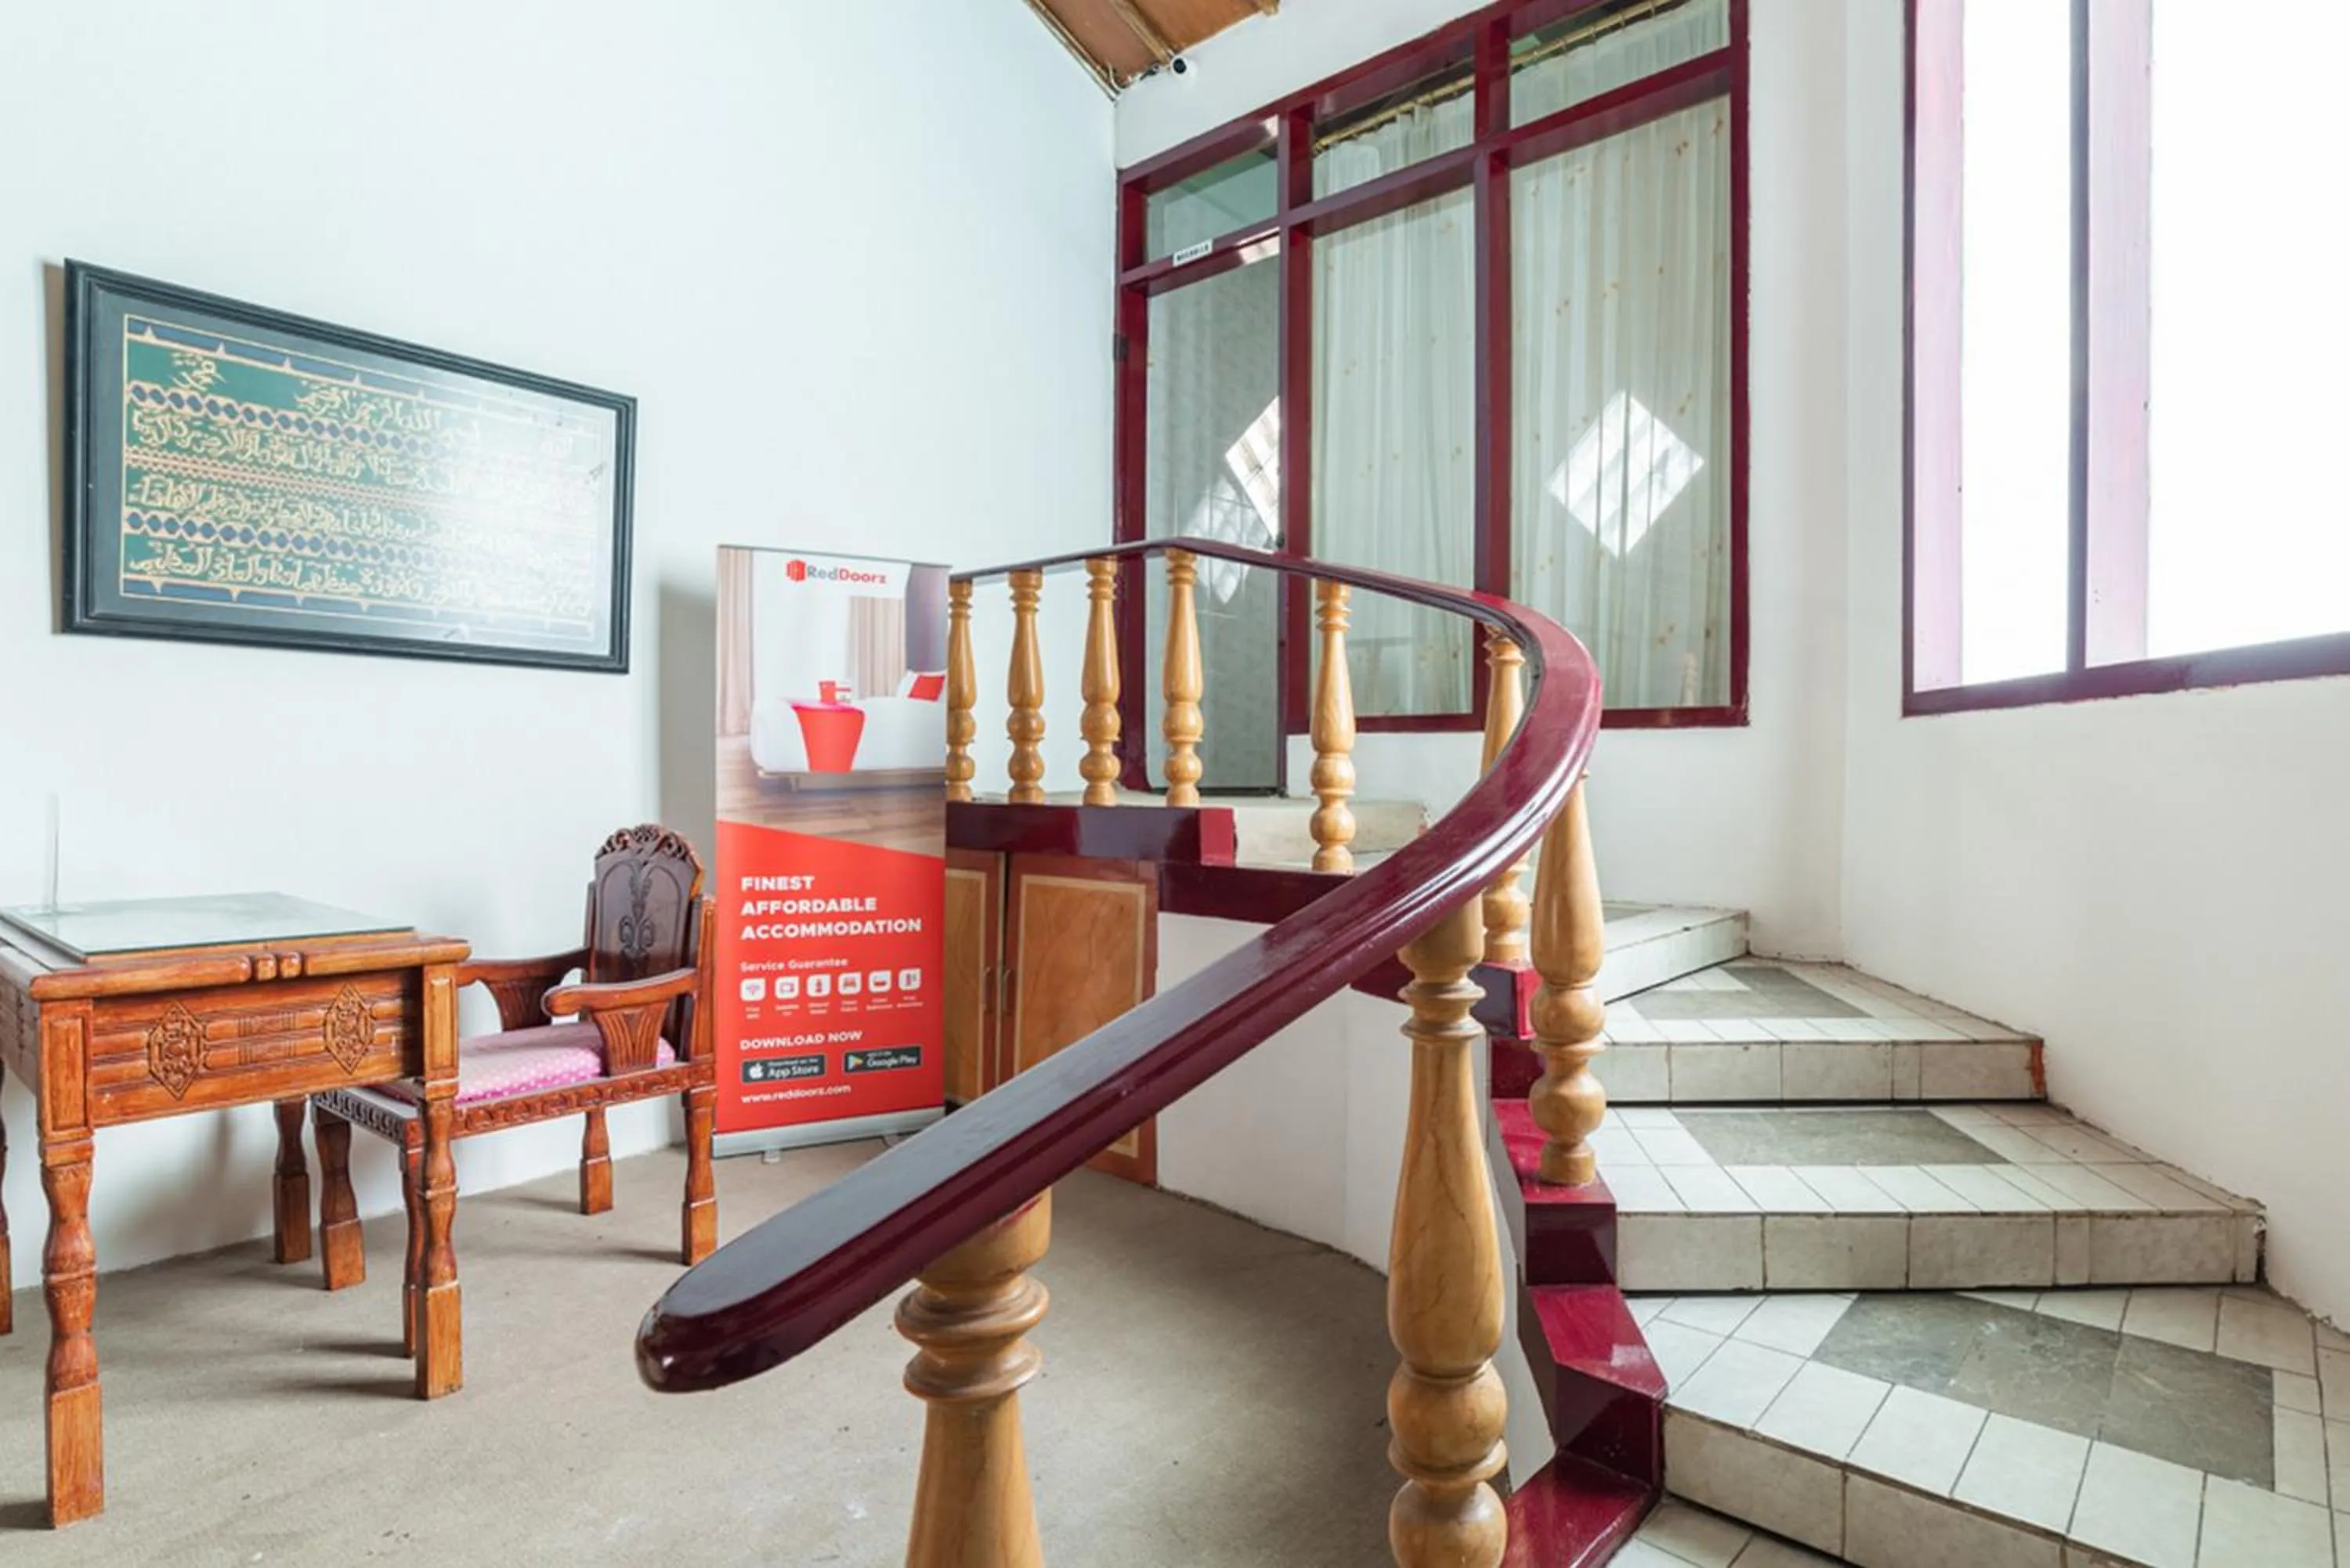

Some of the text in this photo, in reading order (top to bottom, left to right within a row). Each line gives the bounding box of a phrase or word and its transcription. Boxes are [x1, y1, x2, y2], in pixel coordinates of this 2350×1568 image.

[807, 565, 887, 583] RedDoorz
[740, 875, 815, 891] FINEST
[740, 897, 877, 916] AFFORDABLE
[740, 918, 923, 940] ACCOMMODATION
[740, 958, 848, 972] Service Guarantee
[739, 1031, 862, 1050] DOWNLOAD NOW
[866, 1057, 898, 1069] Google
[899, 1054, 918, 1064] Play
[768, 1065, 819, 1079] App Store
